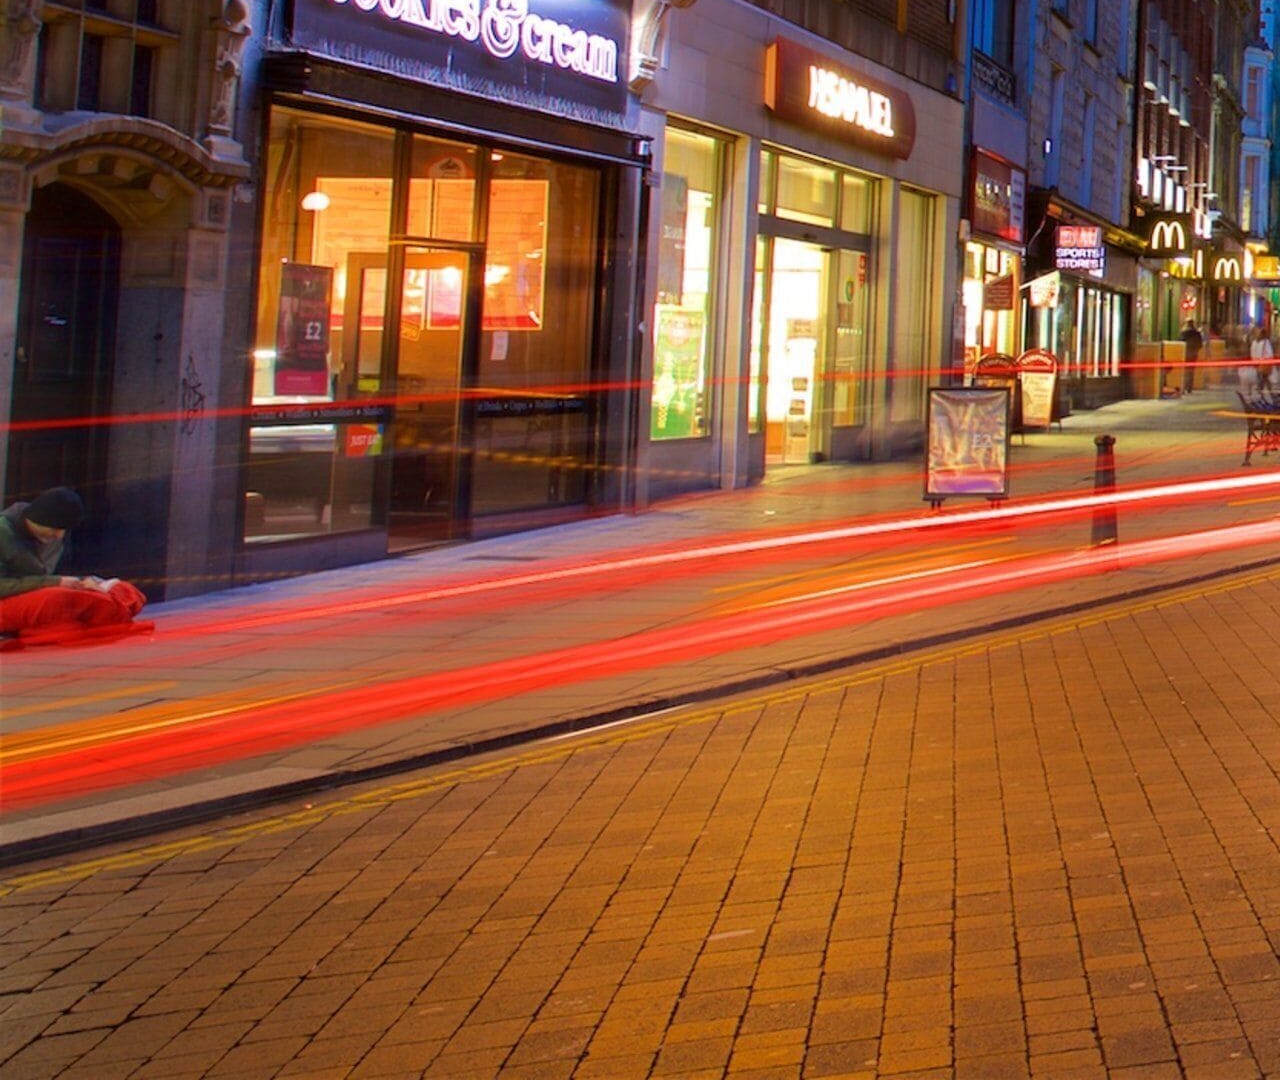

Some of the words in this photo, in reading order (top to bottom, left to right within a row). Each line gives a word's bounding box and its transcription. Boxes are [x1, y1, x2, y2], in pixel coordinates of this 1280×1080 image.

[521, 13, 618, 83] cream
[1055, 247, 1100, 258] SPORTS
[1055, 258, 1100, 269] STORES
[305, 322, 321, 340] £2
[351, 434, 366, 447] JUST
